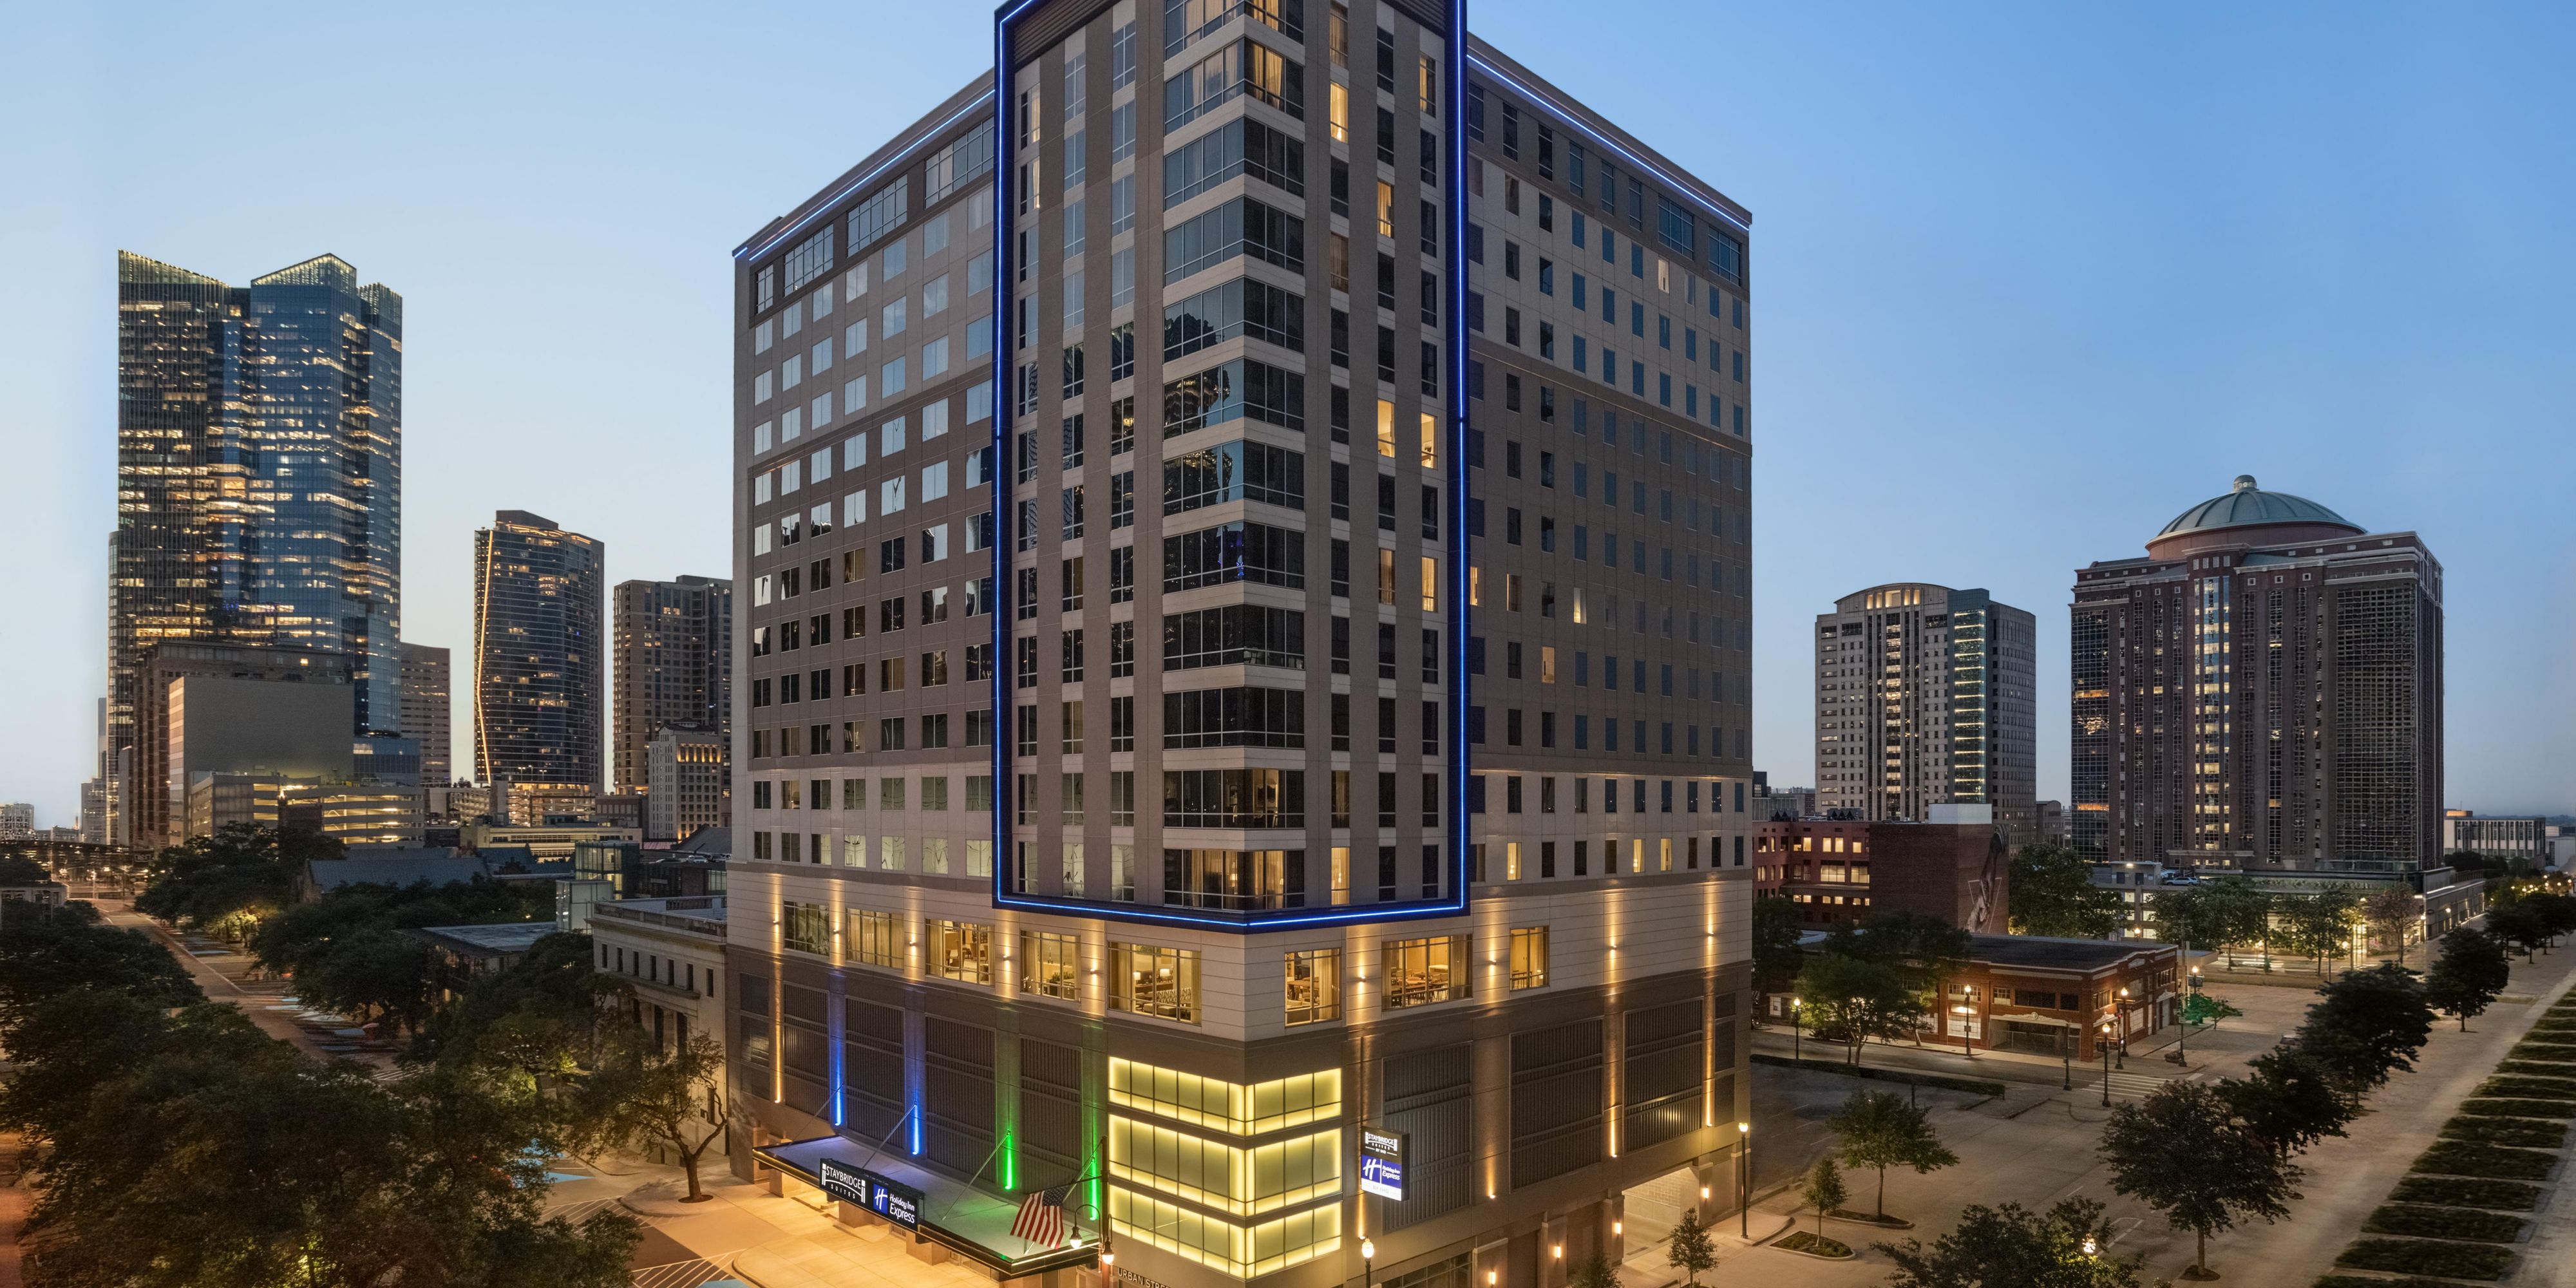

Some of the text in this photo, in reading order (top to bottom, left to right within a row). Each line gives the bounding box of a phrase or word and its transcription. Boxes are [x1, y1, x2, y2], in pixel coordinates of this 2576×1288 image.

[1368, 1133, 1394, 1145] STAYBRIDGE
[826, 1166, 861, 1189] STAYBRIDGE
[1382, 1170, 1400, 1180] Express
[831, 1184, 855, 1199] SUITES
[889, 1193, 907, 1209] Holiday
[889, 1203, 915, 1224] Express
[1118, 1267, 1143, 1285] URBAN
